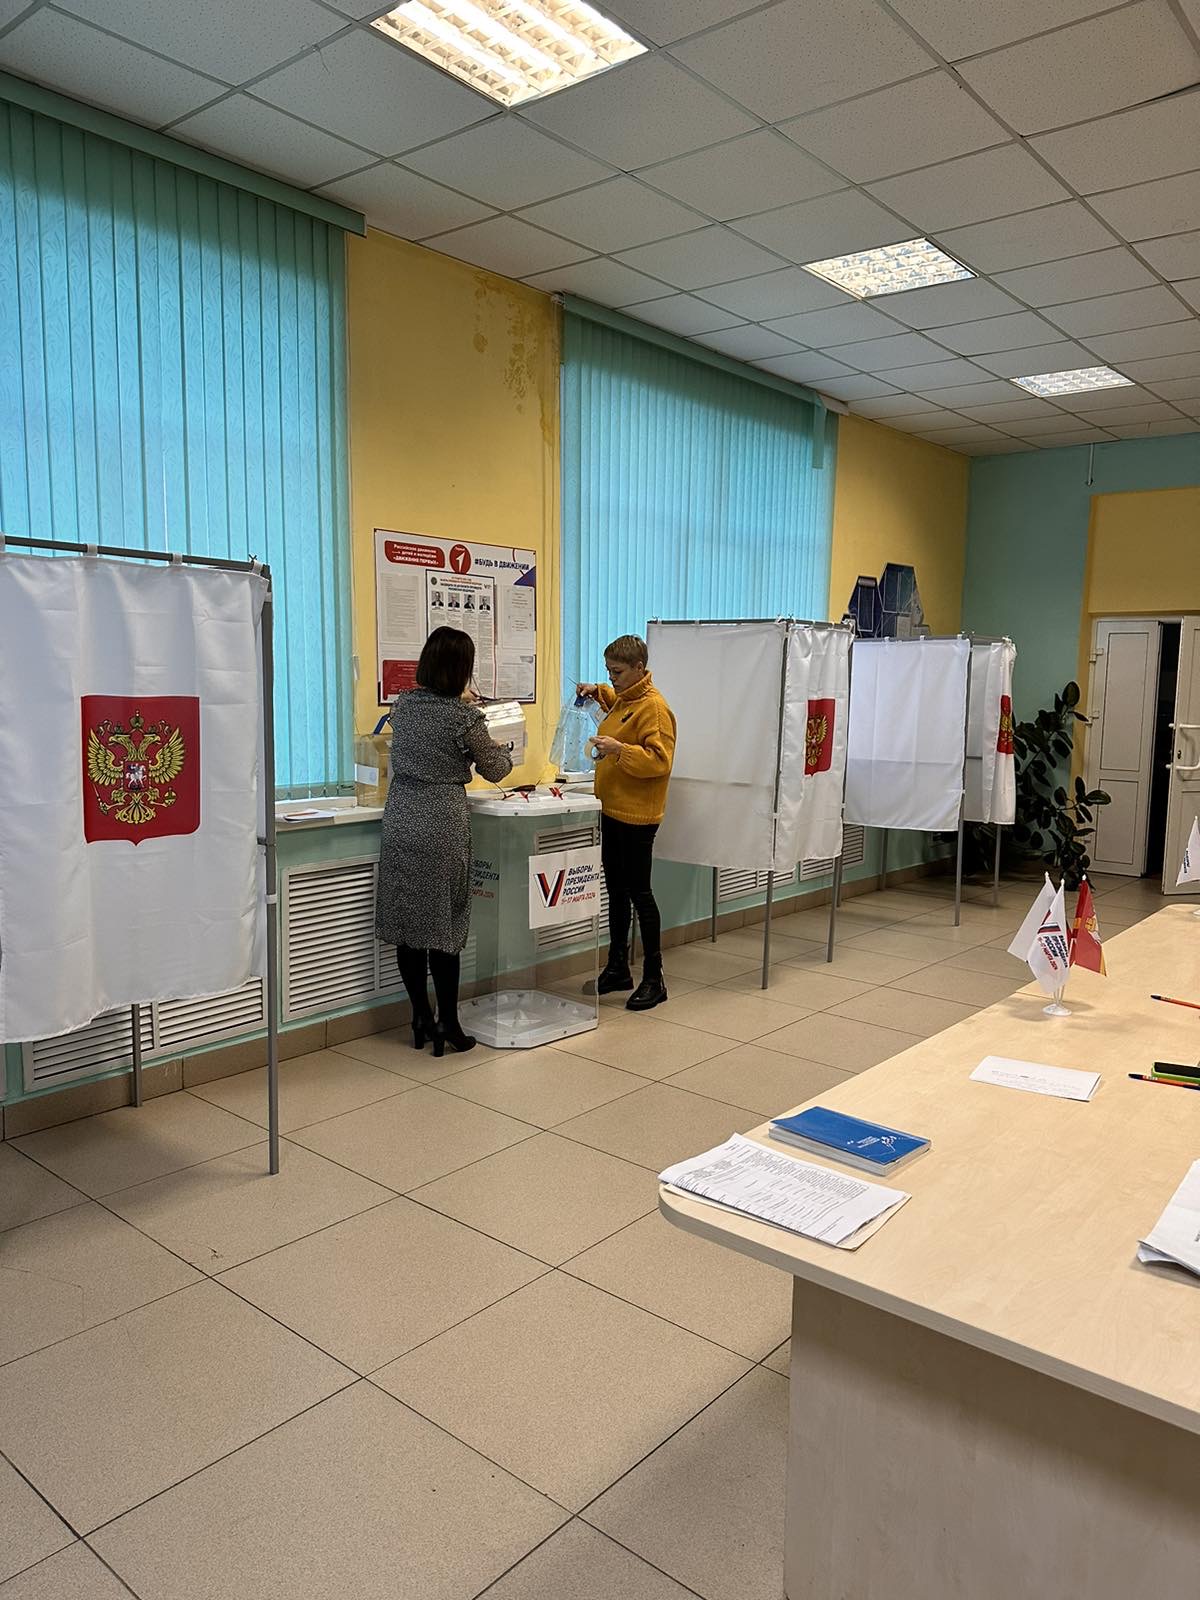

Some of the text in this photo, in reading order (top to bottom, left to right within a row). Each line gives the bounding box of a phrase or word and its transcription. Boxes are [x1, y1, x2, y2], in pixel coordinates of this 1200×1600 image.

[475, 558, 493, 567] #БУДЬ
[499, 561, 530, 571] ДВИЖЕНИИ
[568, 864, 594, 876] ВЫБОРЫ
[564, 873, 600, 887] ПРЕЗИДЕНТА
[562, 884, 586, 896] РОССИИ
